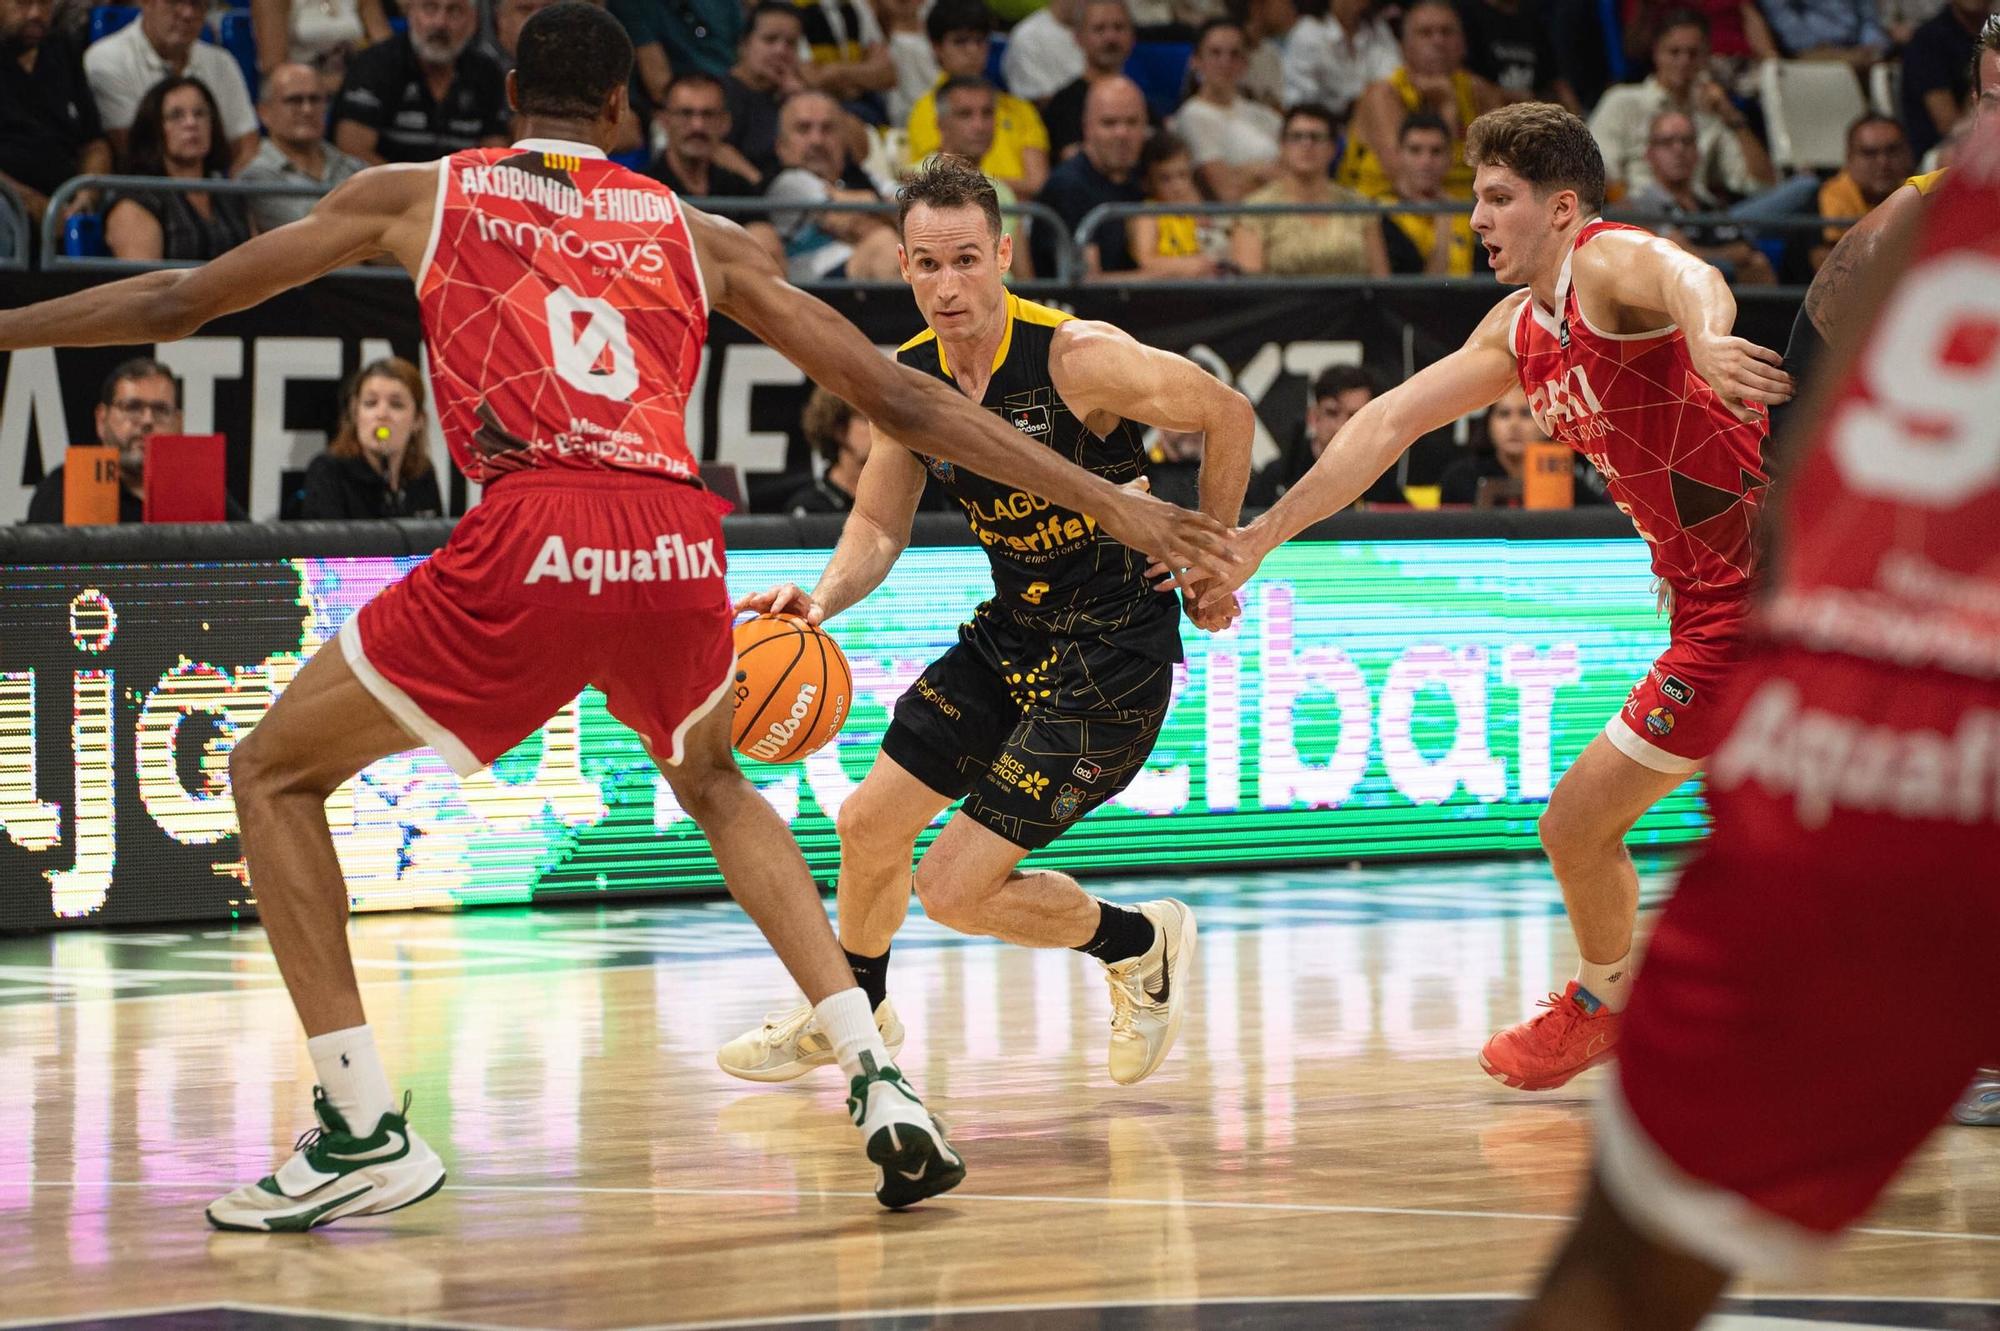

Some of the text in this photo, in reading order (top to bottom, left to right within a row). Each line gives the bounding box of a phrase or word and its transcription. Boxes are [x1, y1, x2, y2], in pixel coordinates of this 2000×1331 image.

[523, 533, 724, 596] Aquaflix
[1664, 683, 1684, 700] acb
[747, 683, 818, 759] Wilson
[1076, 766, 1093, 780] acb
